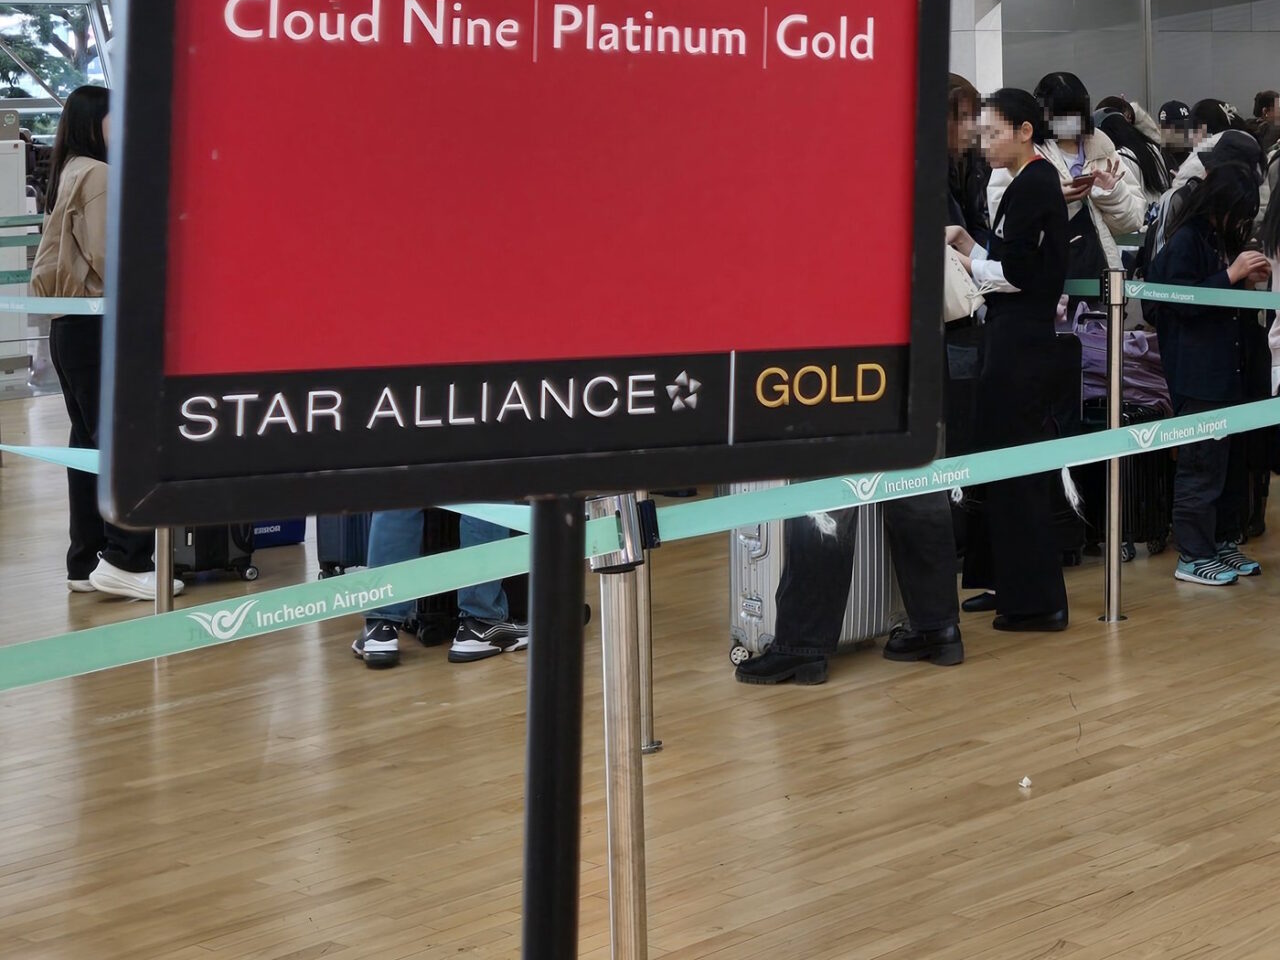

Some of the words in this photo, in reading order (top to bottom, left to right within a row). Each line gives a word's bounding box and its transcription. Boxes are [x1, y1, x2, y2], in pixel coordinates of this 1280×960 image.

[553, 3, 747, 56] Platinum
[776, 13, 875, 60] Gold
[1143, 289, 1169, 300] Incheon
[1171, 291, 1195, 302] Airport
[179, 390, 342, 441] STAR
[366, 373, 656, 430] ALLIANCE
[755, 362, 887, 409] GOLD
[1160, 425, 1194, 442] Incheon
[1197, 416, 1228, 438] Airport
[884, 474, 929, 495] Incheon
[931, 466, 970, 488] Airport
[257, 597, 327, 629] Incheon
[333, 583, 394, 613] Airport
